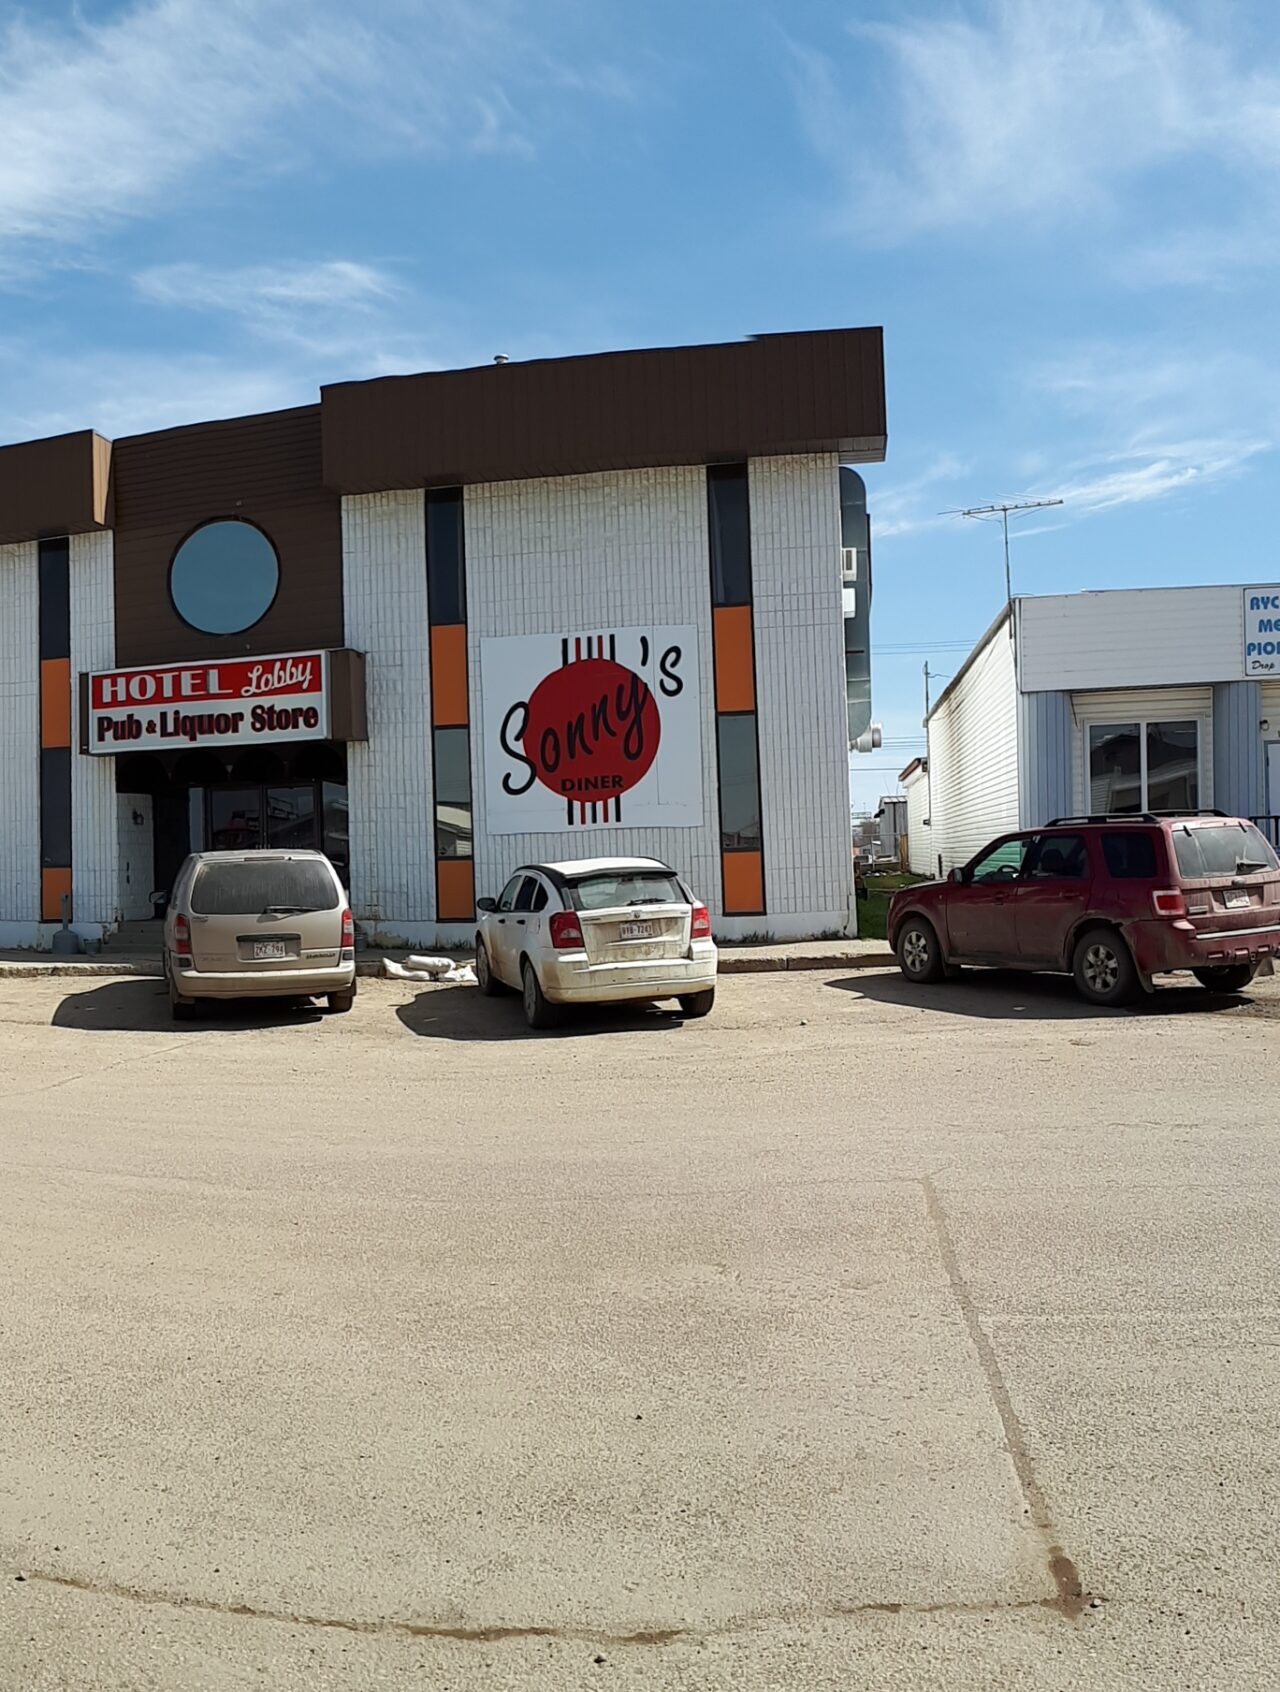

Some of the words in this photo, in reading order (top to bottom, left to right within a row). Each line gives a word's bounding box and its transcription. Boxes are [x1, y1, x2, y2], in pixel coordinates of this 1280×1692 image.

[101, 668, 234, 704] HOTEL
[240, 658, 313, 698] Lobby
[1251, 660, 1276, 671] Drop
[97, 713, 143, 743] Pub
[145, 719, 158, 735] &
[159, 709, 245, 742] Liquor
[250, 703, 320, 733] Store
[500, 635, 684, 796] Sonny's
[560, 774, 624, 792] DINER
